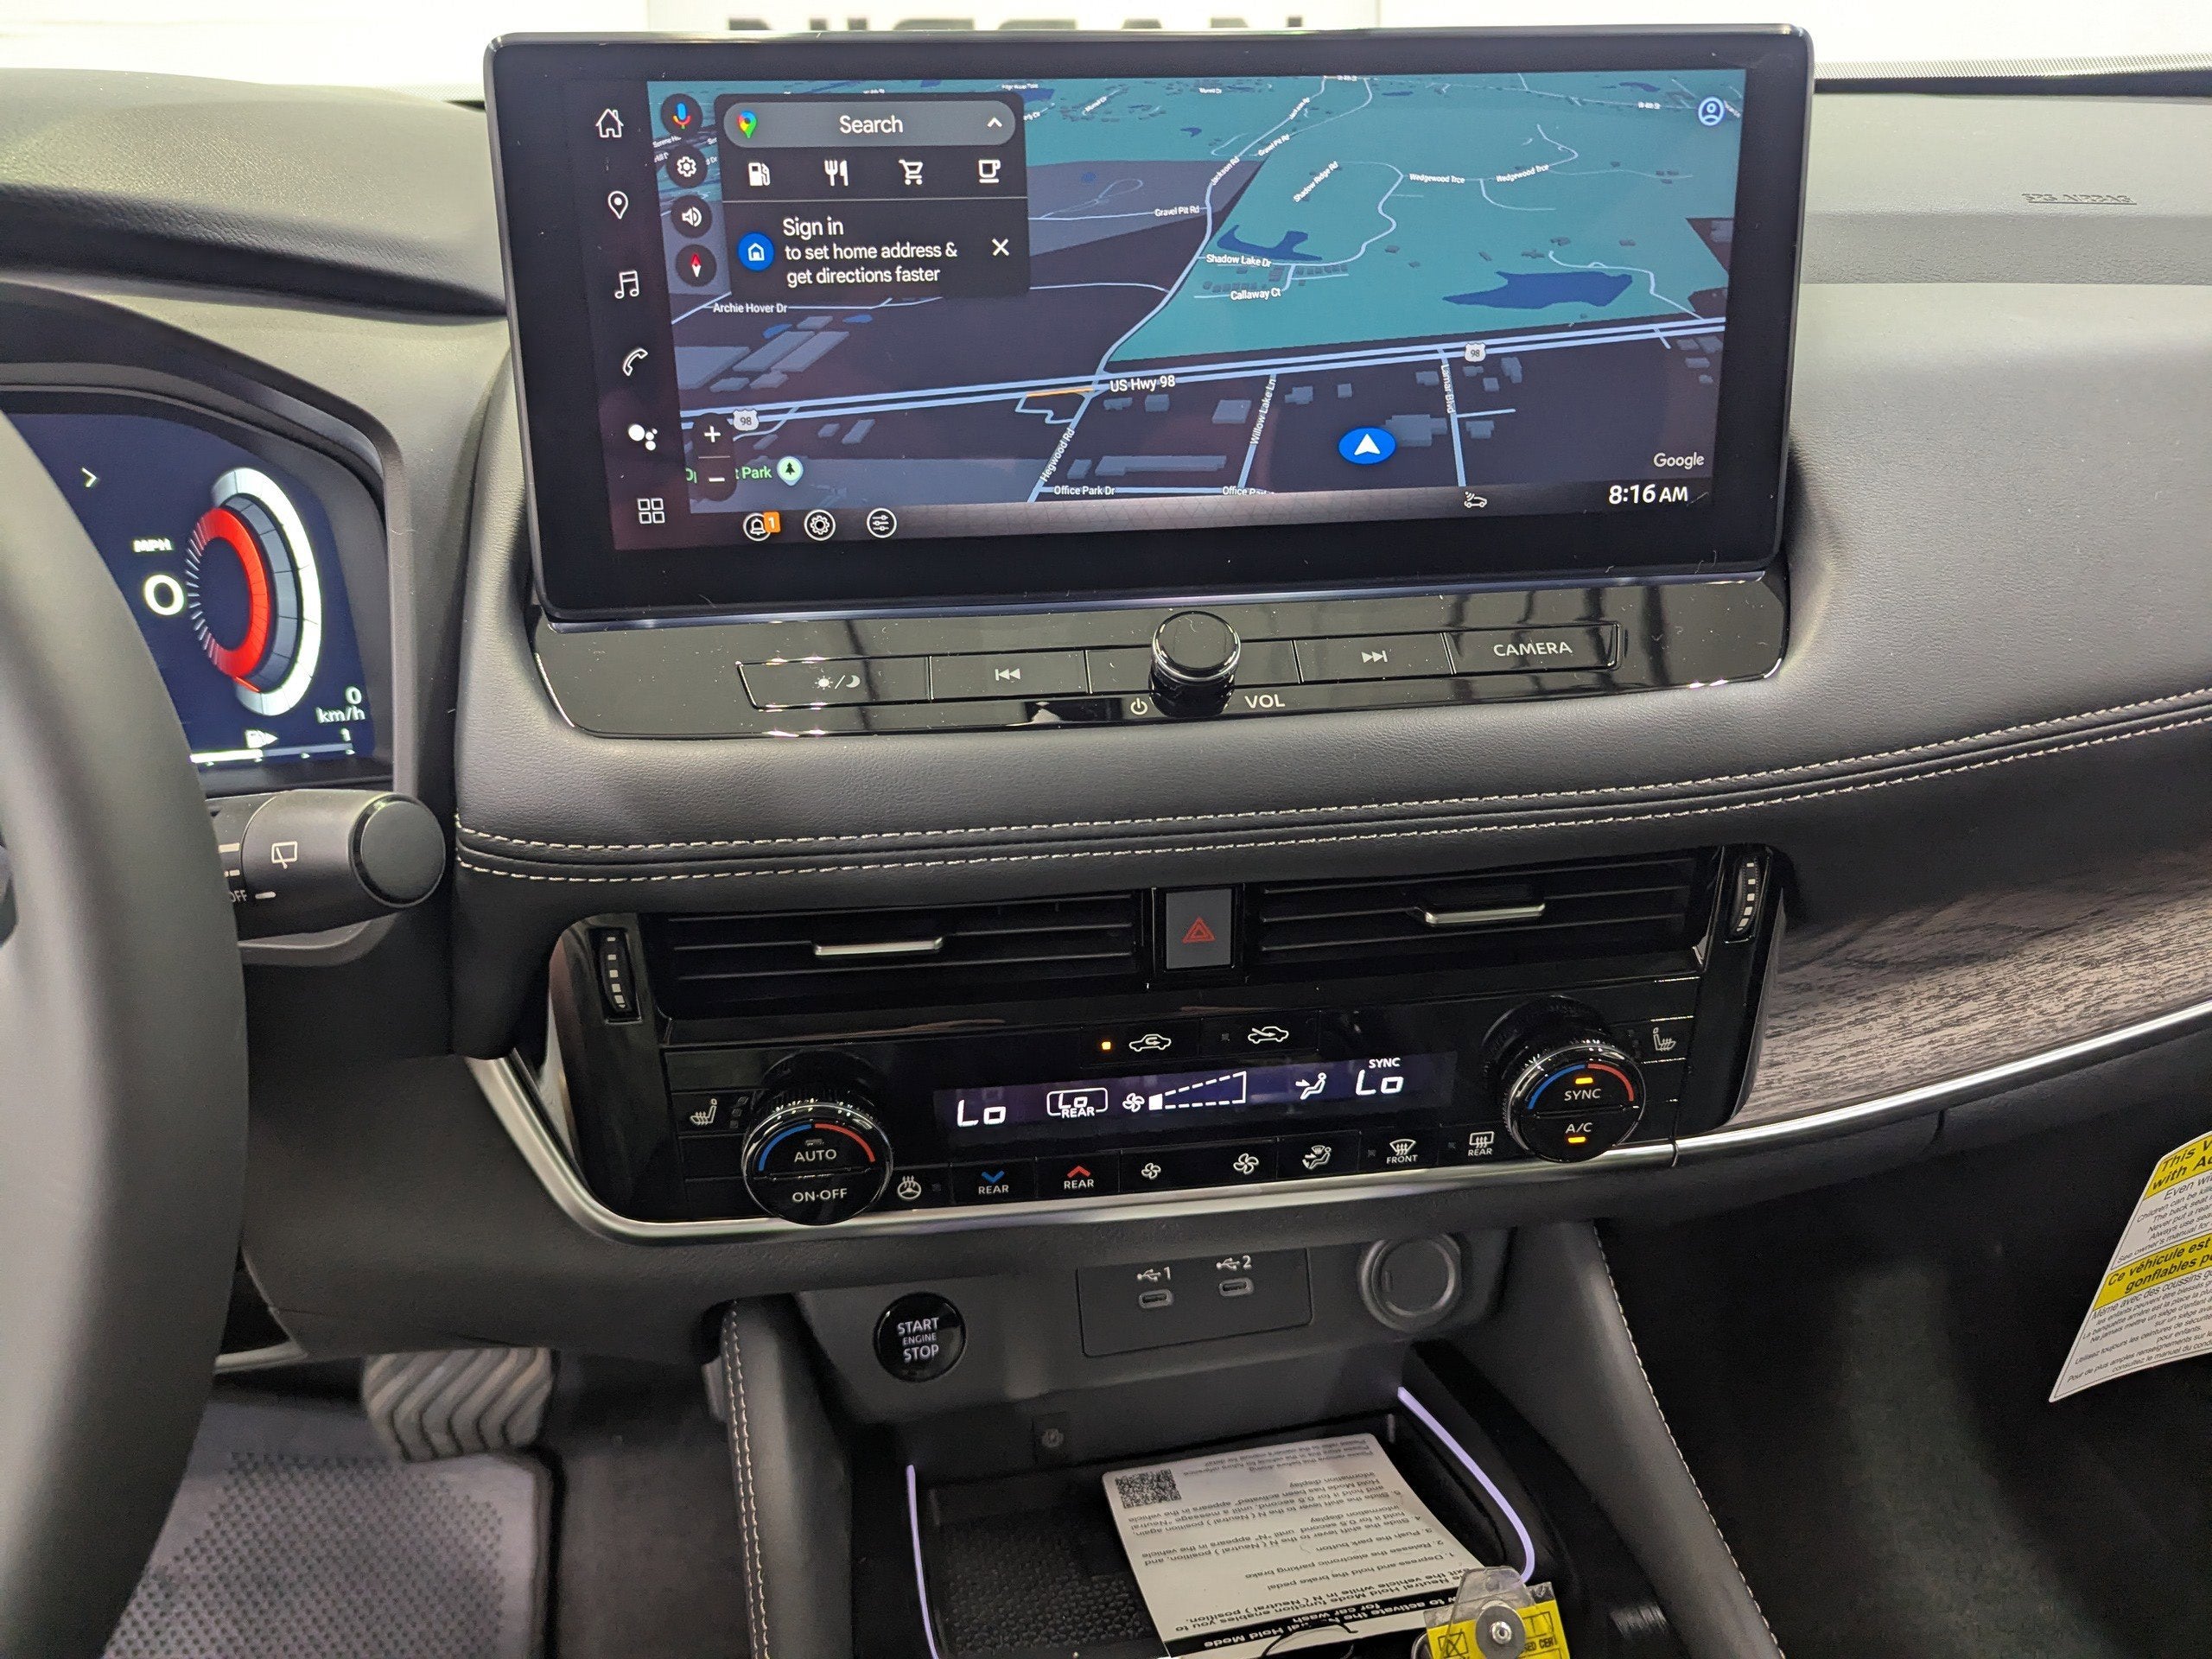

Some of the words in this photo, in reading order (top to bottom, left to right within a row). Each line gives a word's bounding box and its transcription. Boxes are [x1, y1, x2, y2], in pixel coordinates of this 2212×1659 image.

[839, 114, 904, 134] Search
[1211, 164, 1232, 186] Jackson
[1293, 181, 1316, 202] Shadow
[1313, 168, 1331, 184] Ridge
[1328, 160, 1338, 171] Rd
[1409, 173, 1450, 183] Wedgewood
[1154, 207, 1178, 217] Gravel
[1179, 206, 1189, 215] Pit
[1189, 205, 1200, 214] Rd
[783, 216, 823, 240] Sign
[827, 215, 844, 236] in
[785, 245, 801, 260] to
[805, 245, 830, 260] set
[833, 243, 878, 259] home
[881, 241, 942, 258] address
[945, 241, 958, 257] &
[1206, 253, 1239, 264] Shadow
[1241, 255, 1262, 266] Lake
[1262, 258, 1272, 268] Dr
[787, 269, 812, 289] get
[817, 266, 892, 284] directions
[896, 264, 940, 283] faster
[1230, 289, 1270, 301] Callaway
[1271, 287, 1281, 298] Ct
[713, 302, 743, 315] Archie
[745, 302, 775, 315] Hover
[776, 302, 788, 315] Dr
[1470, 347, 1481, 358] 98
[1109, 378, 1128, 394] US
[1130, 377, 1158, 393] Hwy
[1160, 374, 1176, 389] 98
[1267, 378, 1277, 391] Ln
[1440, 363, 1453, 392] Lamar
[1258, 391, 1273, 415] Lake
[1444, 391, 1456, 415] Blvd
[740, 416, 753, 426] 98
[1249, 413, 1268, 446] Willow
[1039, 440, 1067, 483] Hegwood
[1063, 427, 1076, 442] Rd
[1653, 452, 1705, 470] Google
[741, 465, 772, 480] Park
[1053, 485, 1080, 495] Office
[1083, 485, 1103, 495] Park
[1105, 486, 1116, 495] Dr
[1222, 485, 1248, 495] Office
[1608, 484, 1656, 505] 8:16
[1659, 486, 1688, 503] AM
[133, 537, 173, 555] MPH
[143, 573, 186, 617] 0
[1493, 640, 1573, 658] CAMERA
[345, 685, 363, 705] 0
[1244, 694, 1286, 709] VOL
[315, 705, 366, 724] km/h
[340, 728, 352, 742] 1
[1368, 1057, 1402, 1069] SYNC
[1354, 1068, 1405, 1096] Lo
[1058, 1092, 1089, 1109] Lo
[1563, 1087, 1602, 1103] SYNC
[956, 1098, 1007, 1128] Lo
[1061, 1106, 1096, 1119] REAR
[1565, 1121, 1593, 1135] A/C
[793, 1147, 838, 1164] AUTO
[1467, 1145, 1494, 1158] REAR
[1385, 1153, 1419, 1166] FRONT
[2162, 1147, 2196, 1173] This
[1064, 1179, 1095, 1191] REAR
[2152, 1165, 2188, 1191] with
[978, 1184, 1009, 1195] REAR
[2163, 1181, 2195, 1201] Even
[2136, 1204, 2170, 1224] Children
[2170, 1197, 2185, 1207] can
[2152, 1212, 2168, 1224] The
[2169, 1203, 2190, 1217] back
[2190, 1195, 2209, 1208] seat
[2147, 1219, 2172, 1234] Never
[2172, 1212, 2187, 1224] put
[2148, 1224, 2178, 1241] Always
[2179, 1218, 2195, 1229] use
[2133, 1238, 2165, 1256] owner's
[2166, 1224, 2197, 1243] manual
[2197, 1221, 2210, 1230] for
[1242, 1255, 1252, 1269] 2
[2107, 1271, 2126, 1287] Ce
[2129, 1246, 2185, 1276] véhicule
[2187, 1236, 2212, 1254] est
[1163, 1266, 1172, 1281] 1
[2124, 1257, 2197, 1294] gonflables
[2120, 1293, 2143, 1307] avec
[2143, 1286, 2160, 1300] des
[2161, 1272, 2202, 1293] coussins
[897, 1317, 939, 1337] START
[902, 1332, 937, 1347] ENGINE
[903, 1344, 939, 1363] STOP
[1351, 1536, 1373, 1547] park
[1395, 1529, 1421, 1539] Push
[1316, 1542, 1349, 1553] button
[1371, 1549, 1388, 1558] the
[1390, 1541, 1432, 1554] Release
[1277, 1560, 1315, 1574] parking
[1319, 1553, 1369, 1567] electronic
[1399, 1552, 1444, 1567] Depress
[1245, 1569, 1274, 1580] brake
[1332, 1571, 1349, 1580] the
[1352, 1566, 1374, 1576] hold
[1427, 1572, 1446, 1581] the
[1268, 1579, 1297, 1592] pedal
[1300, 1574, 1329, 1585] brake
[1377, 1575, 1422, 1590] vehicle
[1404, 1577, 1449, 1592] Neutral
[1331, 1592, 1366, 1605] Mode
[1342, 1585, 1375, 1597] while
[1370, 1586, 1400, 1598] Hold
[1274, 1599, 1327, 1614] function
[1361, 1601, 1380, 1611] for
[1371, 1601, 1426, 1618] activate
[1430, 1598, 1445, 1607] to
[1186, 1608, 1241, 1625] position.
[1220, 1610, 1270, 1624] enables
[1293, 1611, 1331, 1624] wash
[1335, 1606, 1356, 1616] car
[1344, 1611, 1368, 1622] the
[1176, 1624, 1189, 1633] to
[1193, 1618, 1216, 1630] you
[1249, 1626, 1284, 1640] Hold
[1205, 1635, 1244, 1649] Mode
